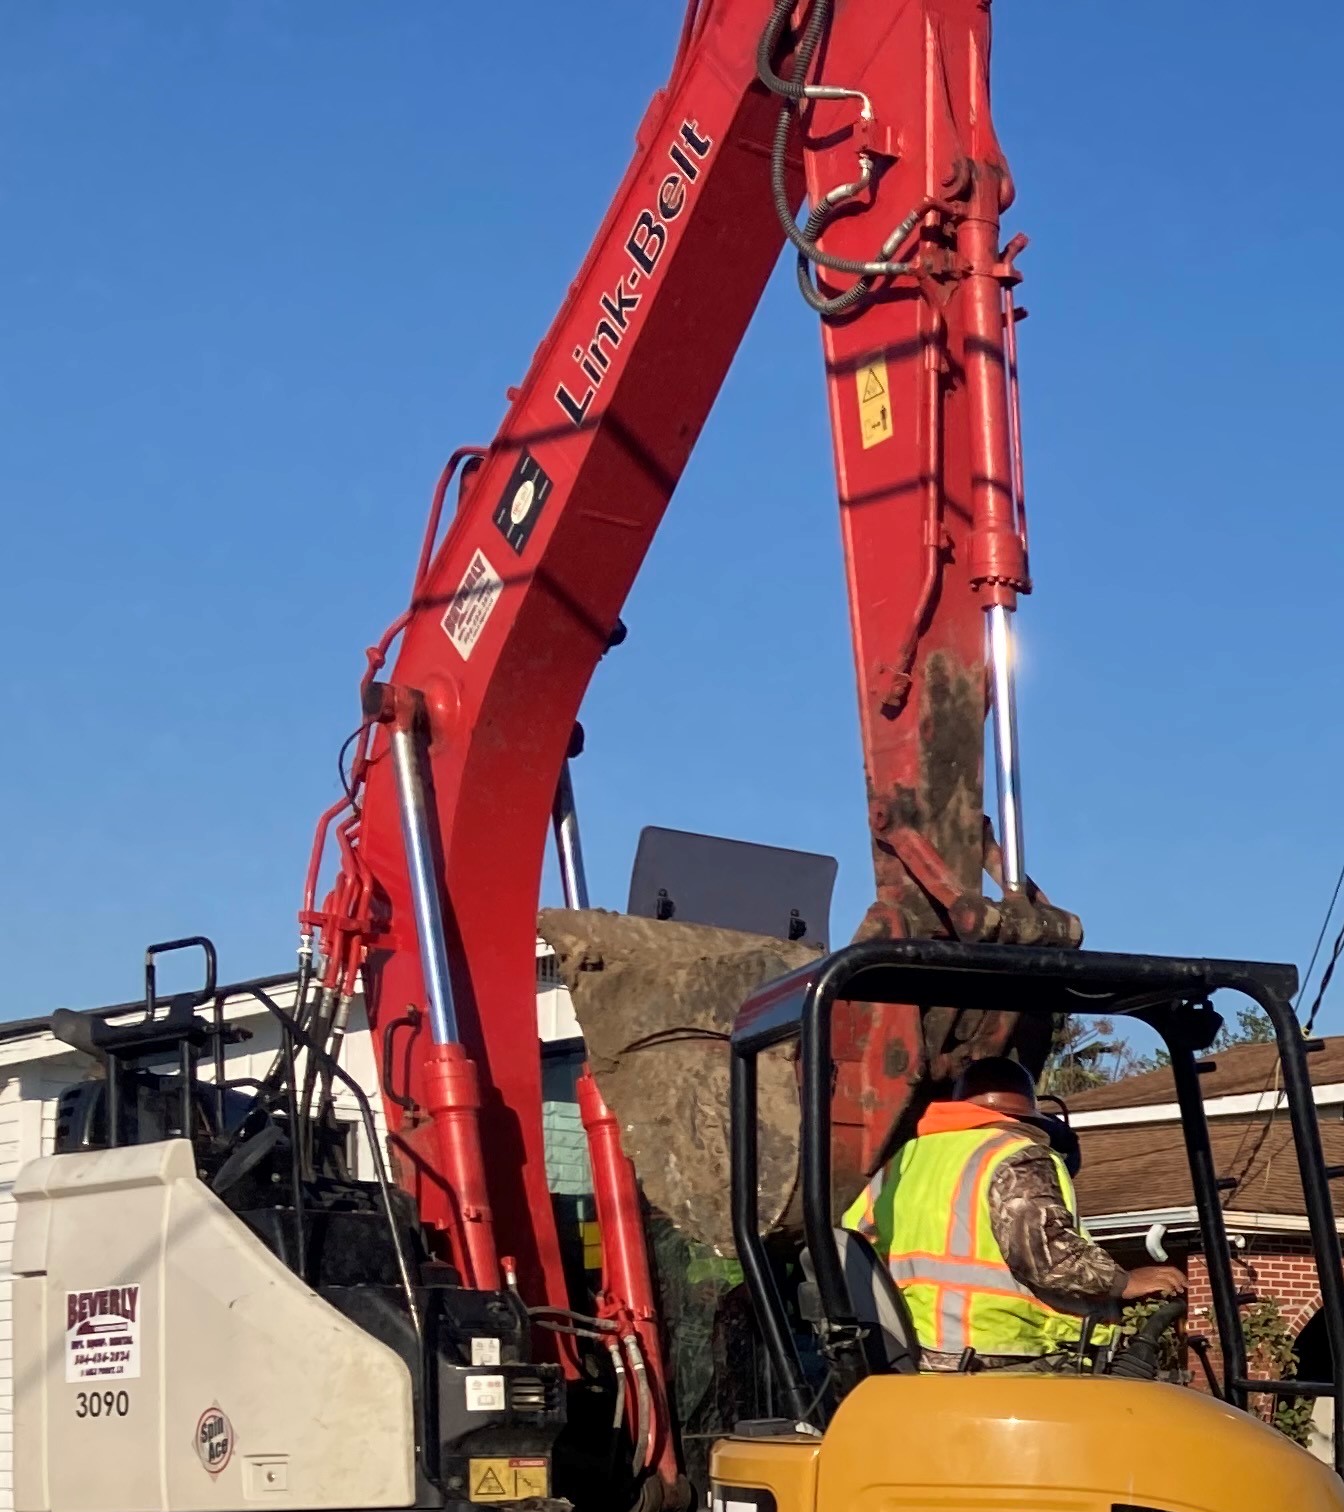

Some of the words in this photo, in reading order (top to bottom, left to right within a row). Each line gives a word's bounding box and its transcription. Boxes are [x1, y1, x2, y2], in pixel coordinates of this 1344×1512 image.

[554, 118, 712, 427] Link-Belt
[67, 1286, 139, 1331] BEVERLY
[76, 1390, 129, 1418] 3090
[201, 1417, 224, 1443] Spin
[208, 1438, 228, 1462] Ace
